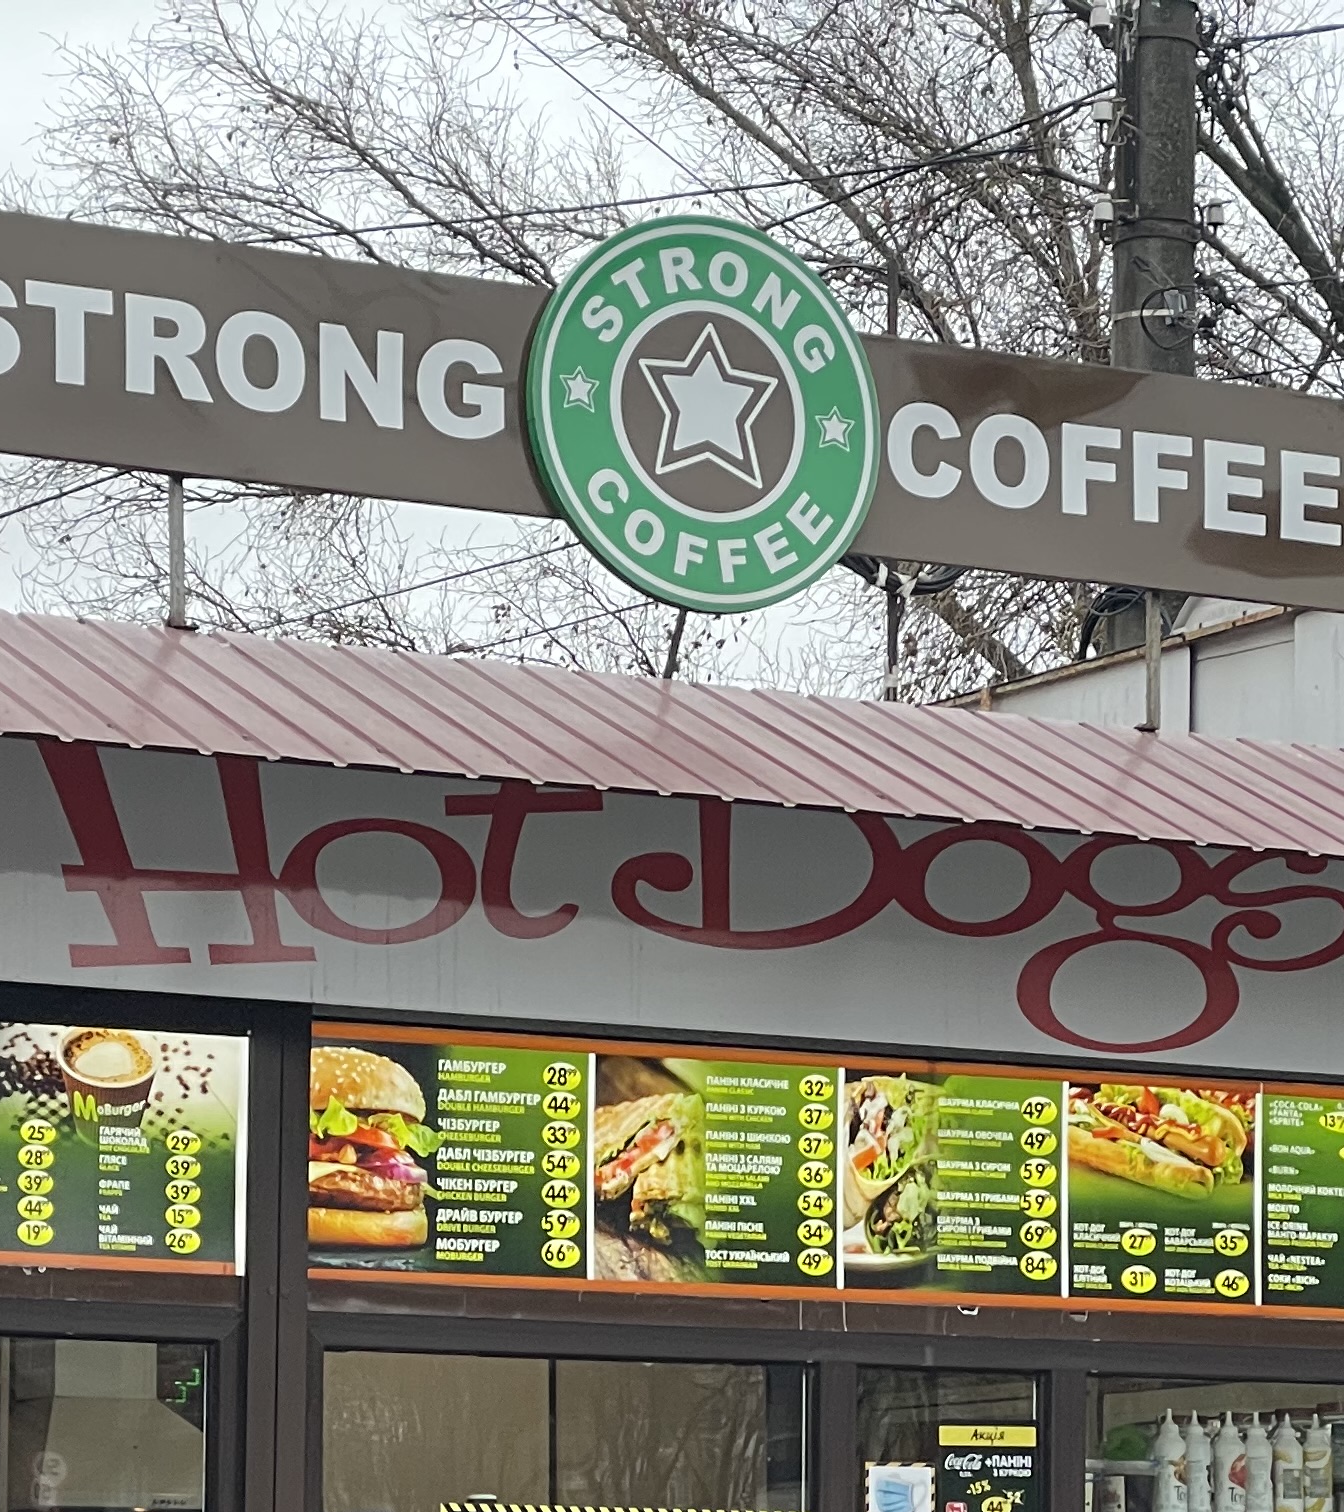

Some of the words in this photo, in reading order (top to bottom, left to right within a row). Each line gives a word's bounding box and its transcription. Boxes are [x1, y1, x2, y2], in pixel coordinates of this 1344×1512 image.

[581, 248, 838, 375] STRONG
[887, 402, 1344, 545] COFFEE
[585, 467, 835, 586] COFFEE
[438, 1059, 506, 1074] ГАМБУРГЕР
[438, 1073, 491, 1083] HAMBURGER
[707, 1076, 738, 1087] ПАНІНІ
[437, 1088, 471, 1102] ДАБЛ
[474, 1091, 541, 1105] ГАМБУРГЕР
[73, 1091, 146, 1122] MoBurger
[473, 1104, 525, 1114] HAMBURGER
[706, 1103, 738, 1113] ПАНІНІ
[747, 1105, 786, 1116] КУРКОЮ
[99, 1126, 141, 1136] ГАРЯЧИЙ
[438, 1118, 500, 1132] ЧІЗБУРГЕР
[99, 1136, 147, 1148] ШОКОЛАД
[438, 1132, 501, 1143] CHEESEBURGER
[706, 1131, 738, 1141] ПАНІНІ
[99, 1155, 127, 1165] ГЛЯСЕ
[437, 1147, 470, 1161] ДАБЛ
[473, 1149, 535, 1163] ЧІЗБУРГЕР
[706, 1154, 738, 1164] ПАНІНІ
[746, 1156, 782, 1165] САЛЯМІ
[99, 1180, 130, 1190] ФРАПЕ
[437, 1178, 472, 1191] ЧІКЕН
[475, 1180, 518, 1193] БУРГЕР
[705, 1194, 738, 1204] ПАНІНІ
[739, 1196, 757, 1206] XXL
[99, 1204, 119, 1214] ЧАЙ
[436, 1207, 478, 1223] ДРАЙВ
[480, 1210, 523, 1224] БУРГЕР
[99, 1224, 118, 1234] ЧАЙ
[705, 1220, 736, 1232] ПАНІНІ
[436, 1238, 500, 1252] МОБУРГЕР
[705, 1250, 728, 1260] ТОСТ
[971, 1428, 1005, 1445] Акція
